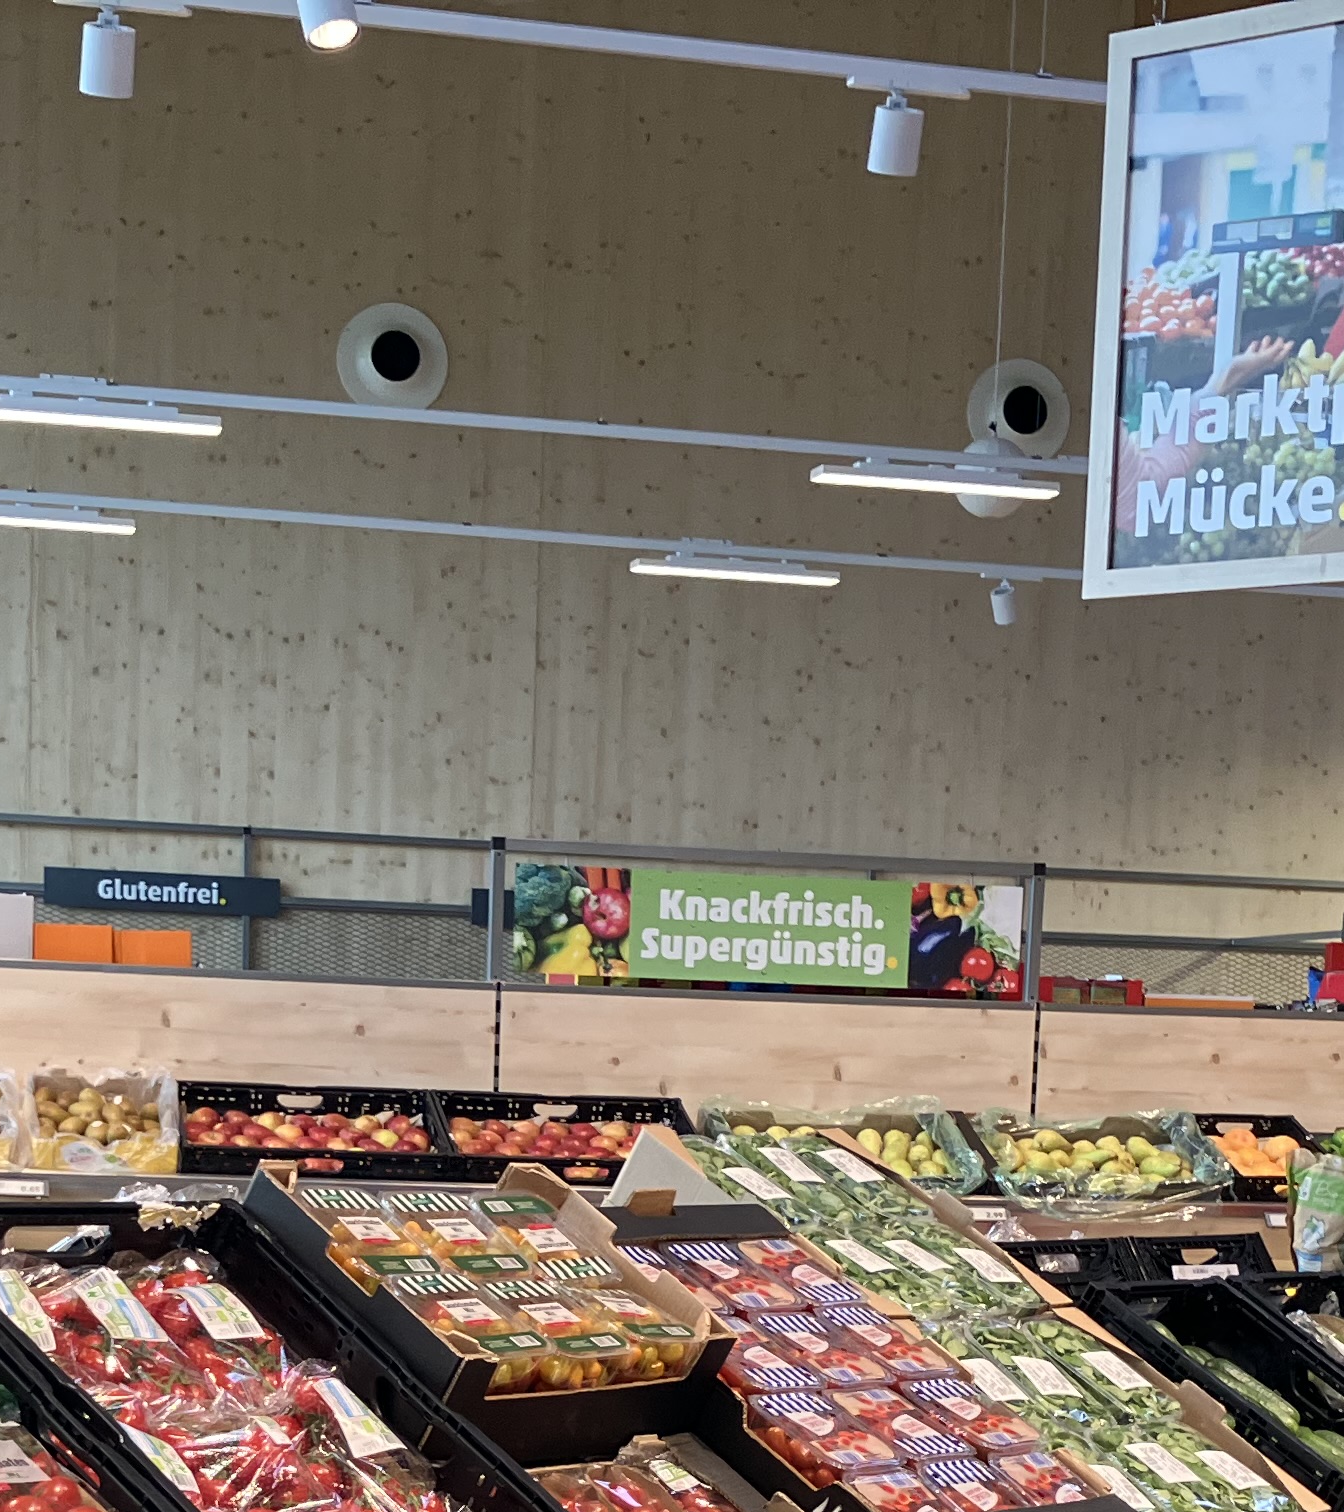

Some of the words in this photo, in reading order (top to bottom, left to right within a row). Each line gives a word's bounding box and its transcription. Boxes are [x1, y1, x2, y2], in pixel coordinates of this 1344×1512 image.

[97, 878, 227, 907] Glutenfrei.
[659, 888, 885, 930] Knackfrisch.
[640, 927, 898, 976] Supergünstig.
